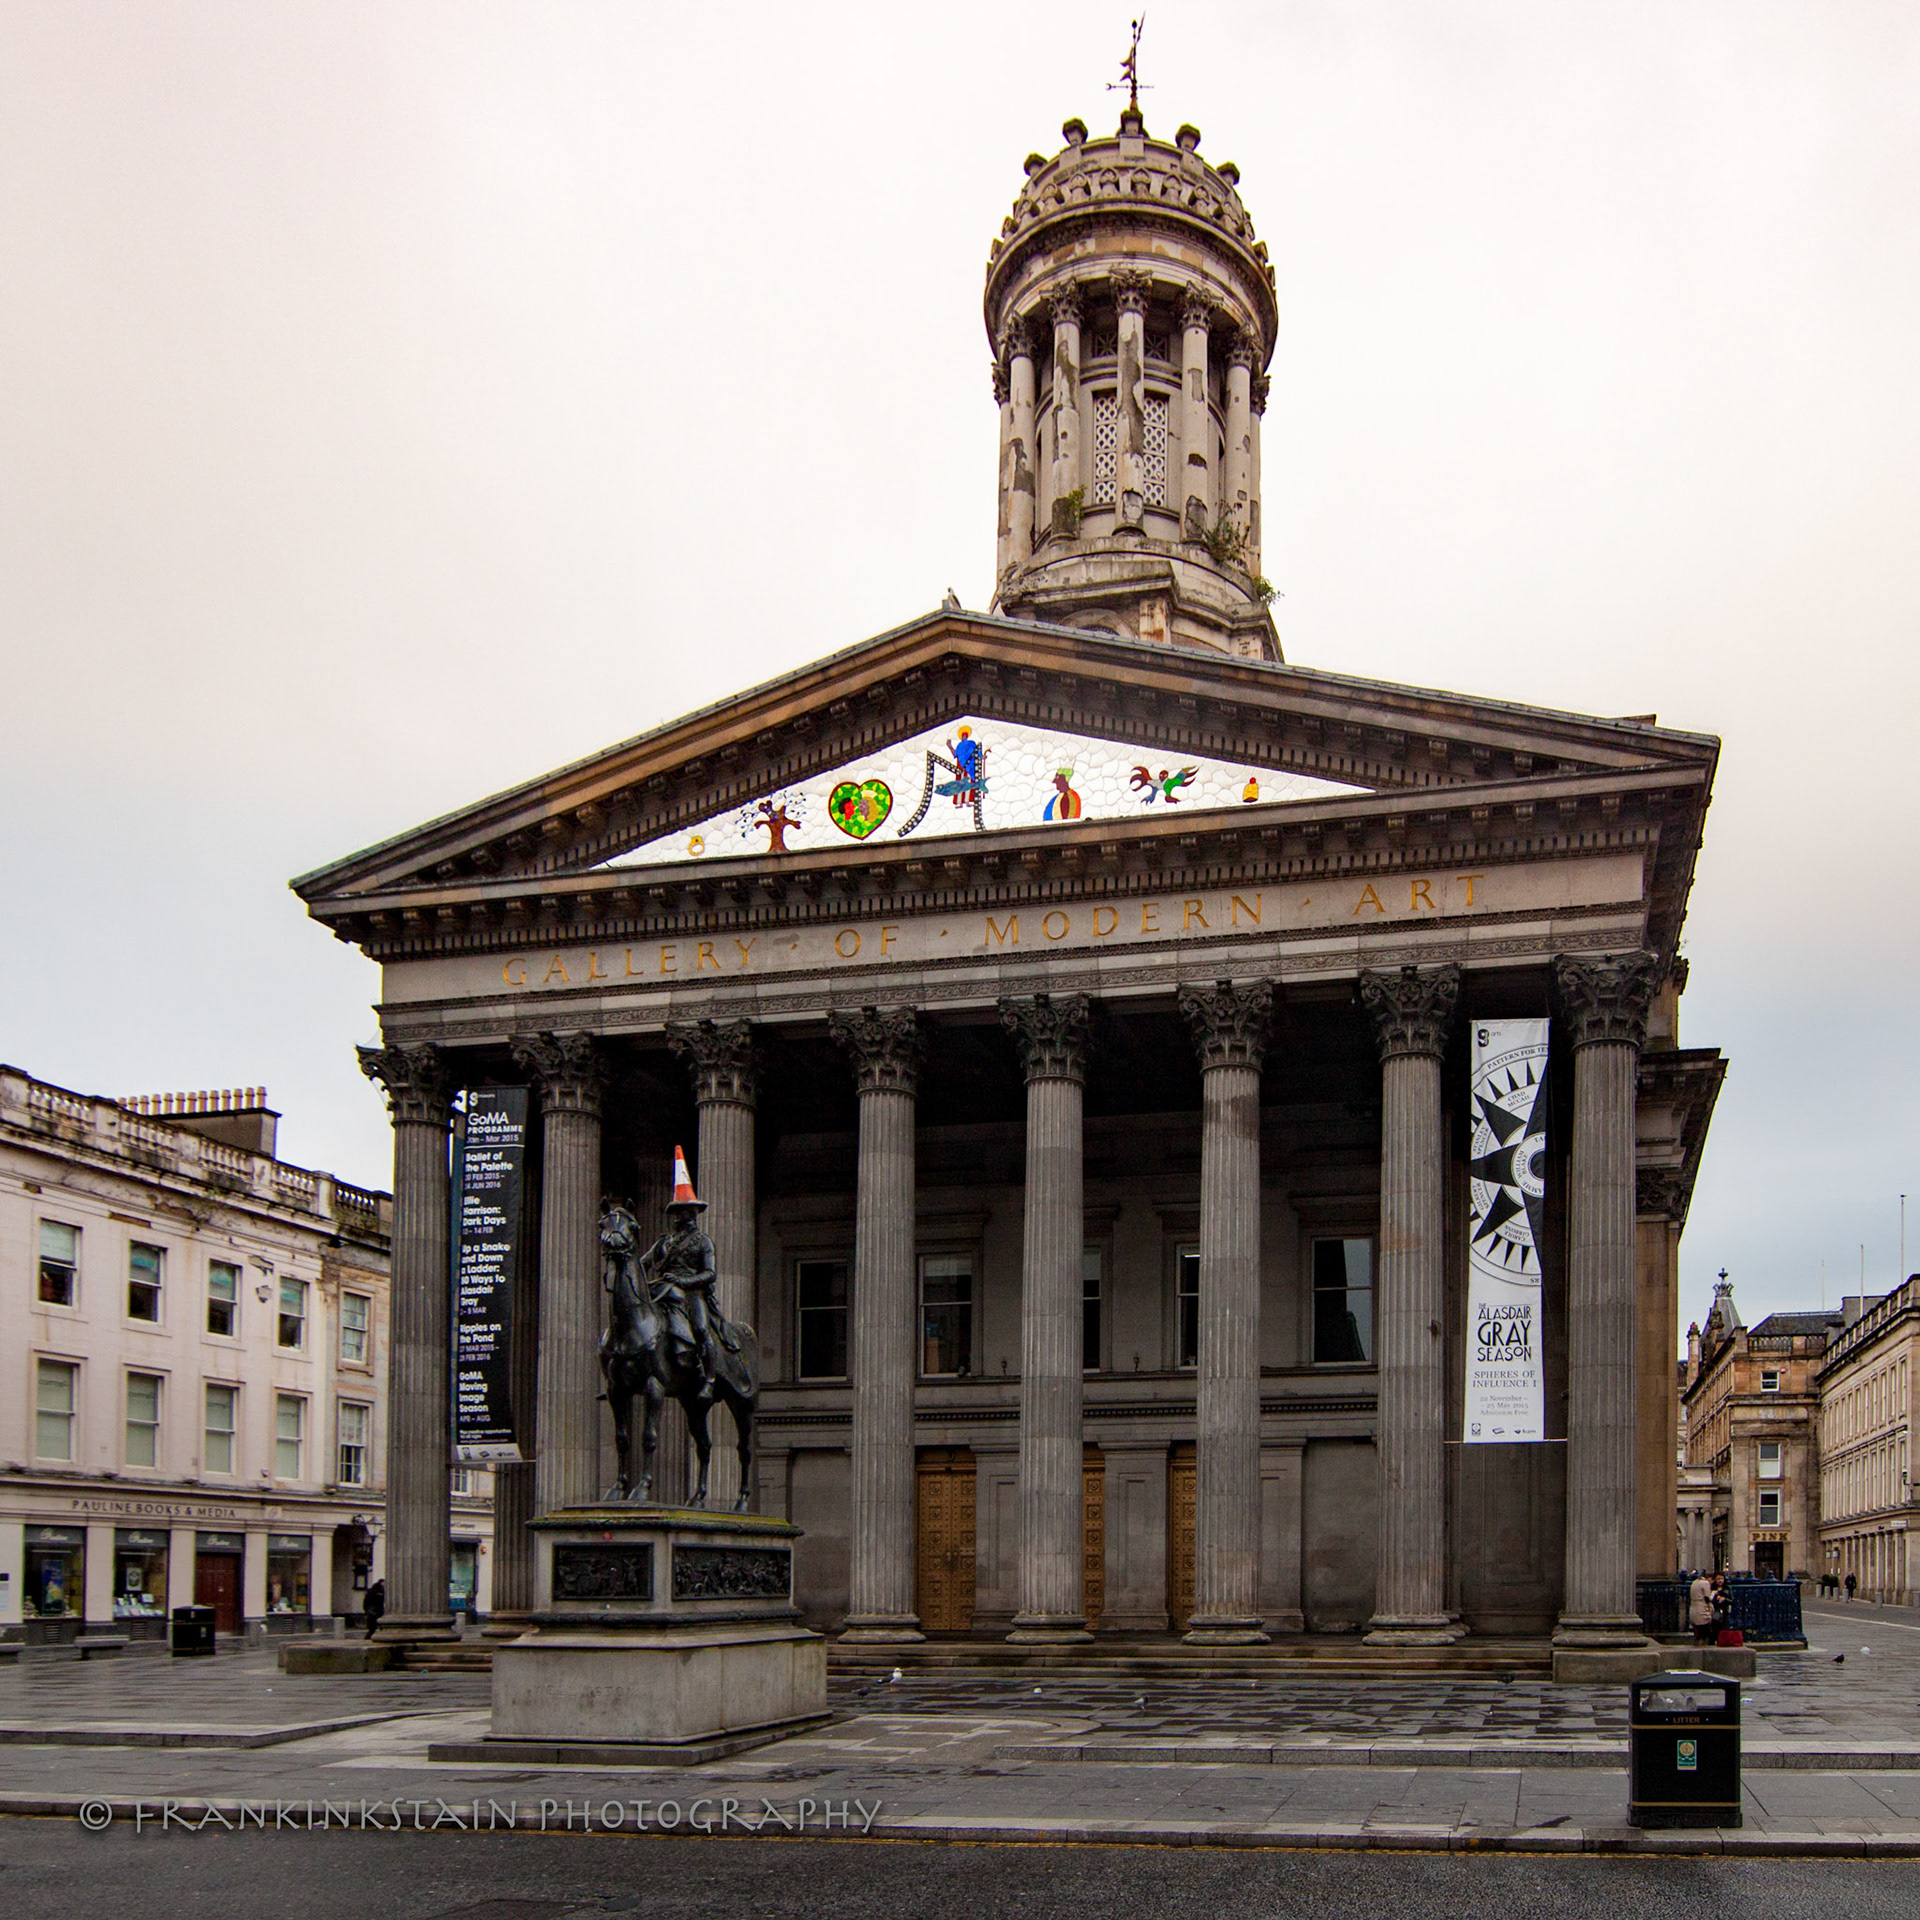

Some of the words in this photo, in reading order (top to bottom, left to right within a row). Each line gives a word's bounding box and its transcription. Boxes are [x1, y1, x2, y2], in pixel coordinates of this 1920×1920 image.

[503, 938, 756, 986] GALLERY
[835, 925, 899, 958] OF
[984, 893, 1262, 946] MODERN
[1354, 874, 1485, 915] ART
[1487, 1052, 1520, 1069] PATTERN
[1520, 1049, 1536, 1058] FOR
[1507, 1091, 1526, 1101] CHAD
[468, 1111, 509, 1126] GoMA
[467, 1125, 523, 1135] PROGRAMME
[466, 1136, 480, 1144] Jan
[486, 1135, 500, 1143] Mar
[501, 1134, 519, 1142] 2015
[465, 1152, 491, 1162] Ballet
[492, 1151, 503, 1161] of
[465, 1163, 480, 1173] the
[481, 1161, 514, 1172] Palette
[463, 1216, 482, 1226] Dark
[483, 1215, 507, 1226] Days
[481, 1242, 511, 1252] Snake
[461, 1254, 476, 1264] and
[478, 1253, 504, 1263] Down
[467, 1264, 500, 1274] Ladder:
[470, 1274, 494, 1285] Ways
[495, 1274, 506, 1283] to
[461, 1285, 494, 1296] Alasdair
[1478, 1306, 1531, 1320] ALASDAIR
[460, 1323, 488, 1334] Ripples
[489, 1323, 502, 1332] on
[1478, 1320, 1531, 1346] GRAY
[472, 1333, 494, 1343] Pond
[1477, 1346, 1531, 1362] SEASON
[459, 1371, 483, 1381] GoMA
[1474, 1370, 1519, 1379] SPHERES
[1522, 1370, 1536, 1378] OF
[459, 1382, 488, 1393] Moving
[1472, 1379, 1529, 1388] INFLUENCE
[459, 1393, 485, 1404] Image
[459, 1403, 489, 1413] Season
[72, 1500, 131, 1513] PAULINE
[136, 1503, 180, 1515] BOOKS
[185, 1507, 192, 1515] &
[198, 1507, 236, 1518] MEDIA
[1752, 1532, 1788, 1541] PINK
